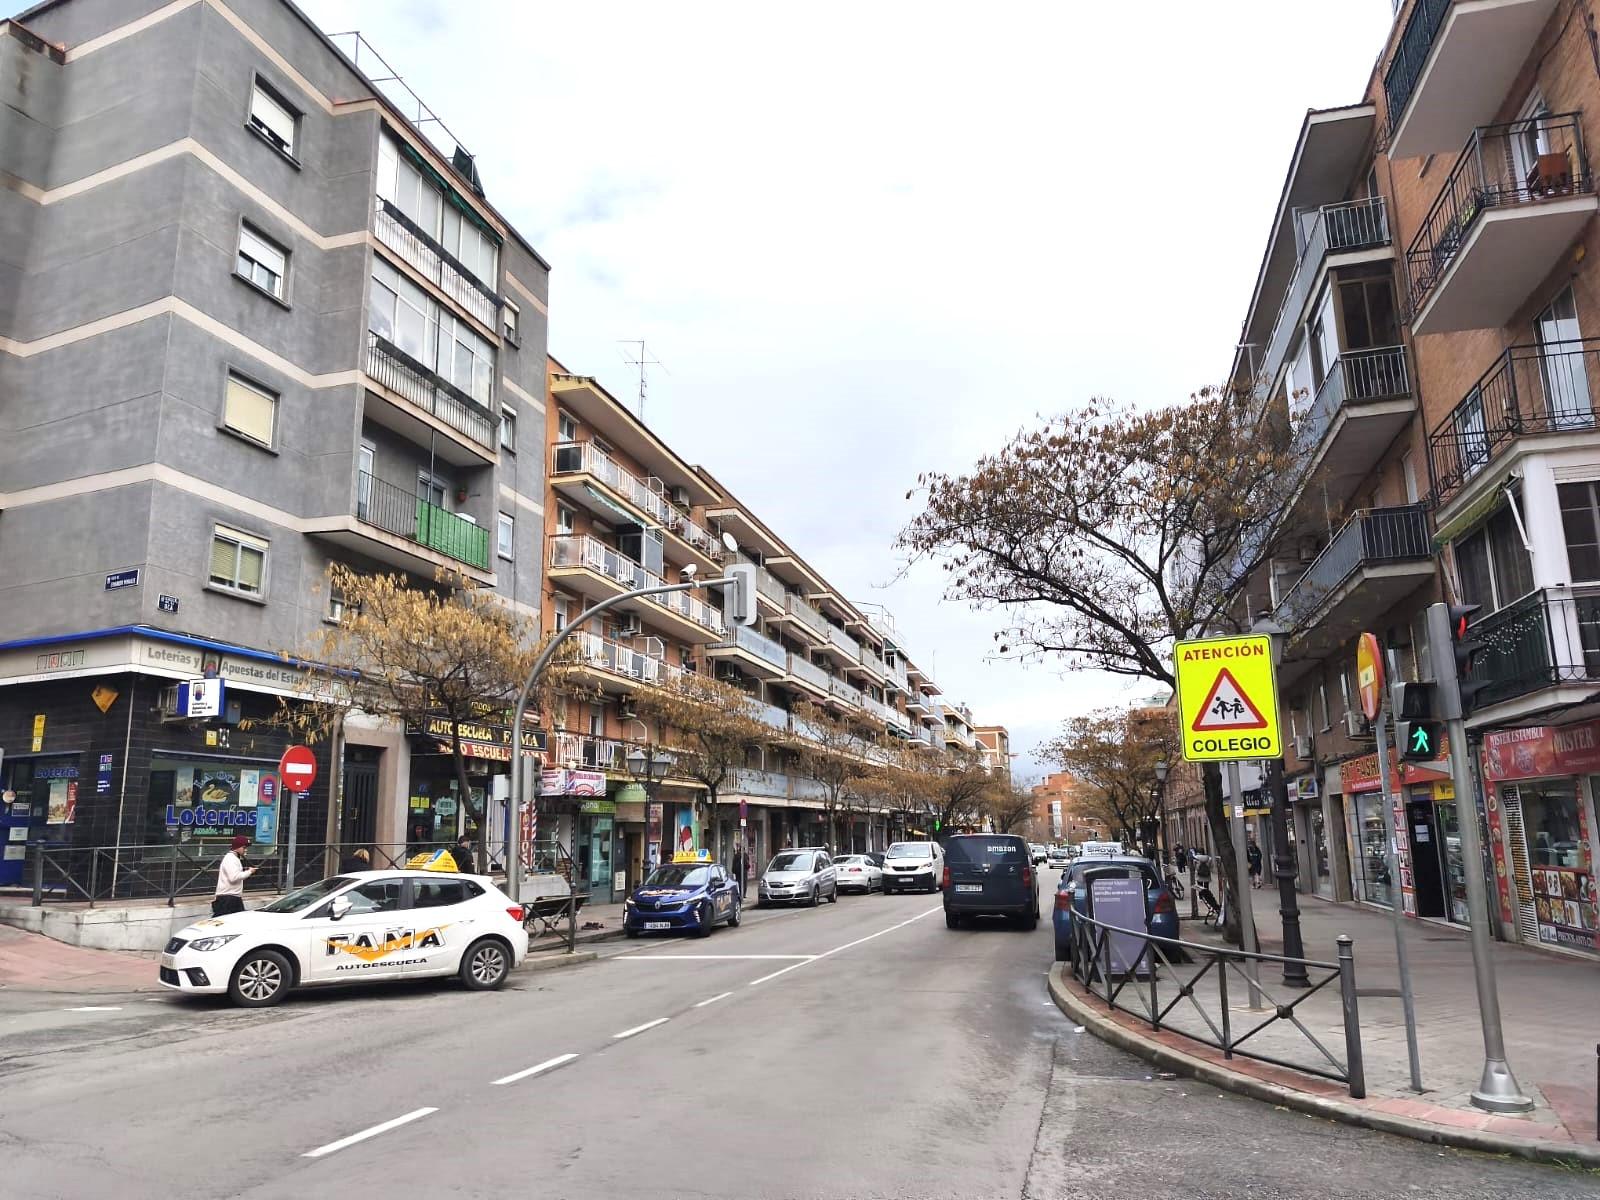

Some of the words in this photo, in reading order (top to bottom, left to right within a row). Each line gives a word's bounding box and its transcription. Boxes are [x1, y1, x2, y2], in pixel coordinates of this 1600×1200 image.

[147, 647, 192, 664] Loterías
[192, 657, 200, 668] y
[1184, 642, 1264, 661] ATENCIÓN
[222, 661, 264, 679] Apuestas
[265, 669, 280, 681] del
[458, 724, 493, 741] ESCUELA
[503, 730, 539, 747] FMA
[1192, 737, 1271, 752] COLEGIO
[1489, 731, 1512, 746] MISTER
[1512, 726, 1544, 742] ESTAMBUL
[1553, 727, 1595, 753] MISTER
[165, 804, 257, 826] Loterías
[326, 926, 446, 957] FAMA
[335, 958, 428, 971] AUTOESCUELA
